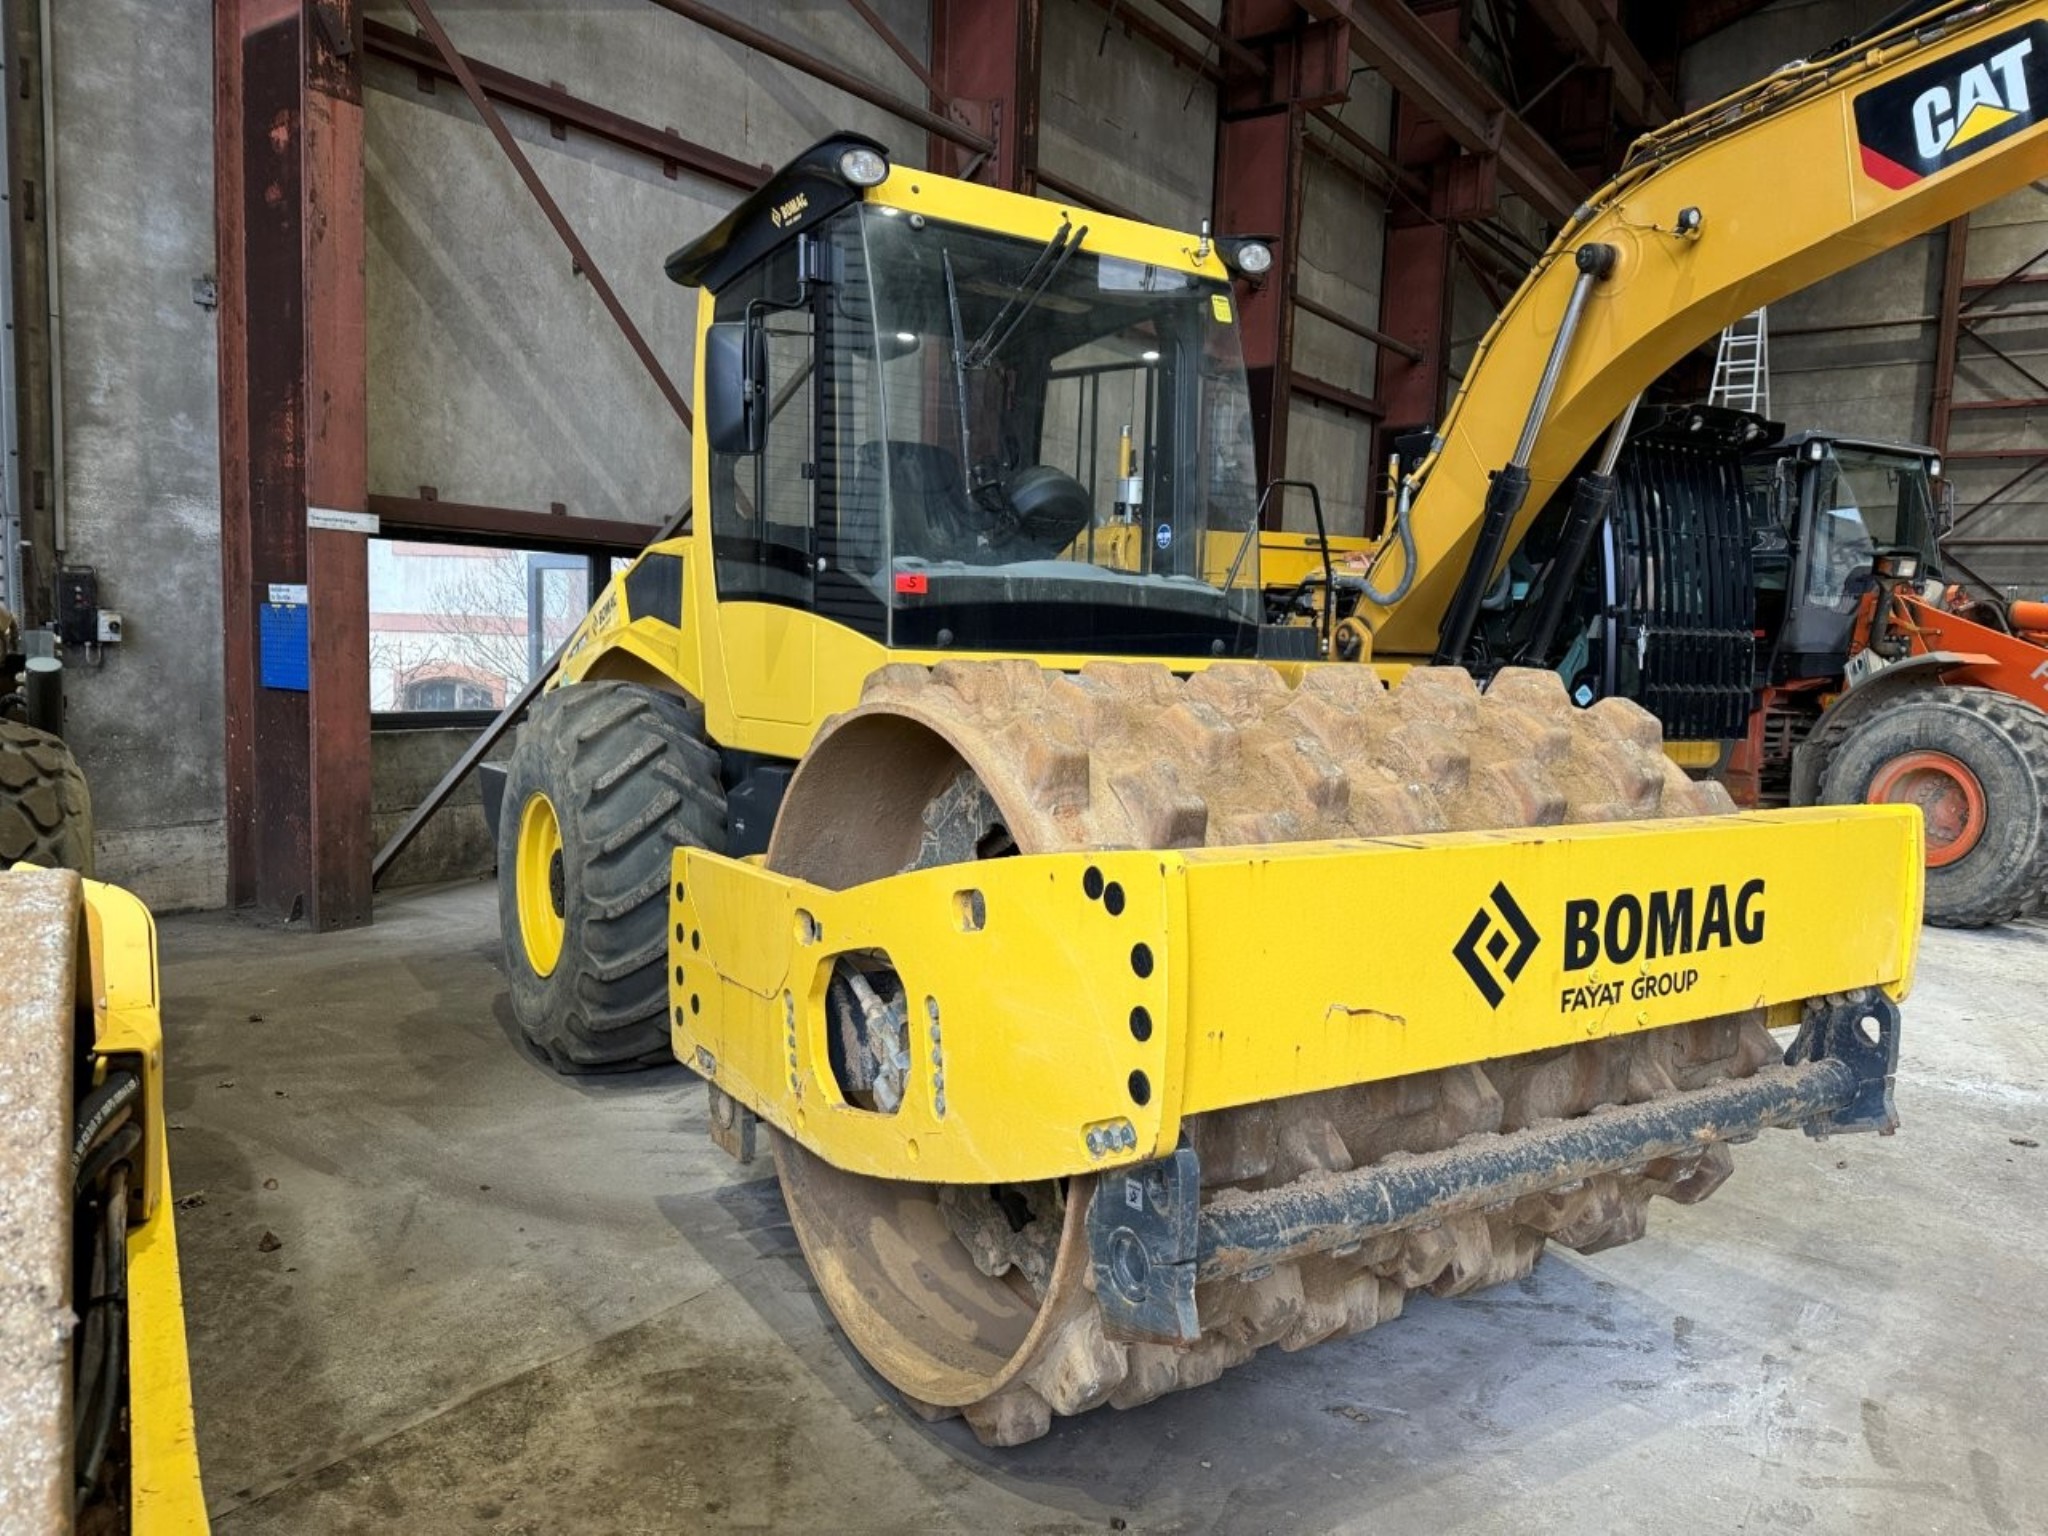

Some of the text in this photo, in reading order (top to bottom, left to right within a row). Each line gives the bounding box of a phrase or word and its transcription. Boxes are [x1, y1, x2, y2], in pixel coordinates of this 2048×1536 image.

[1912, 38, 2032, 158] CAT
[1563, 878, 1765, 971] BOMAG
[1560, 969, 1698, 1013] FAYAT GROUP
